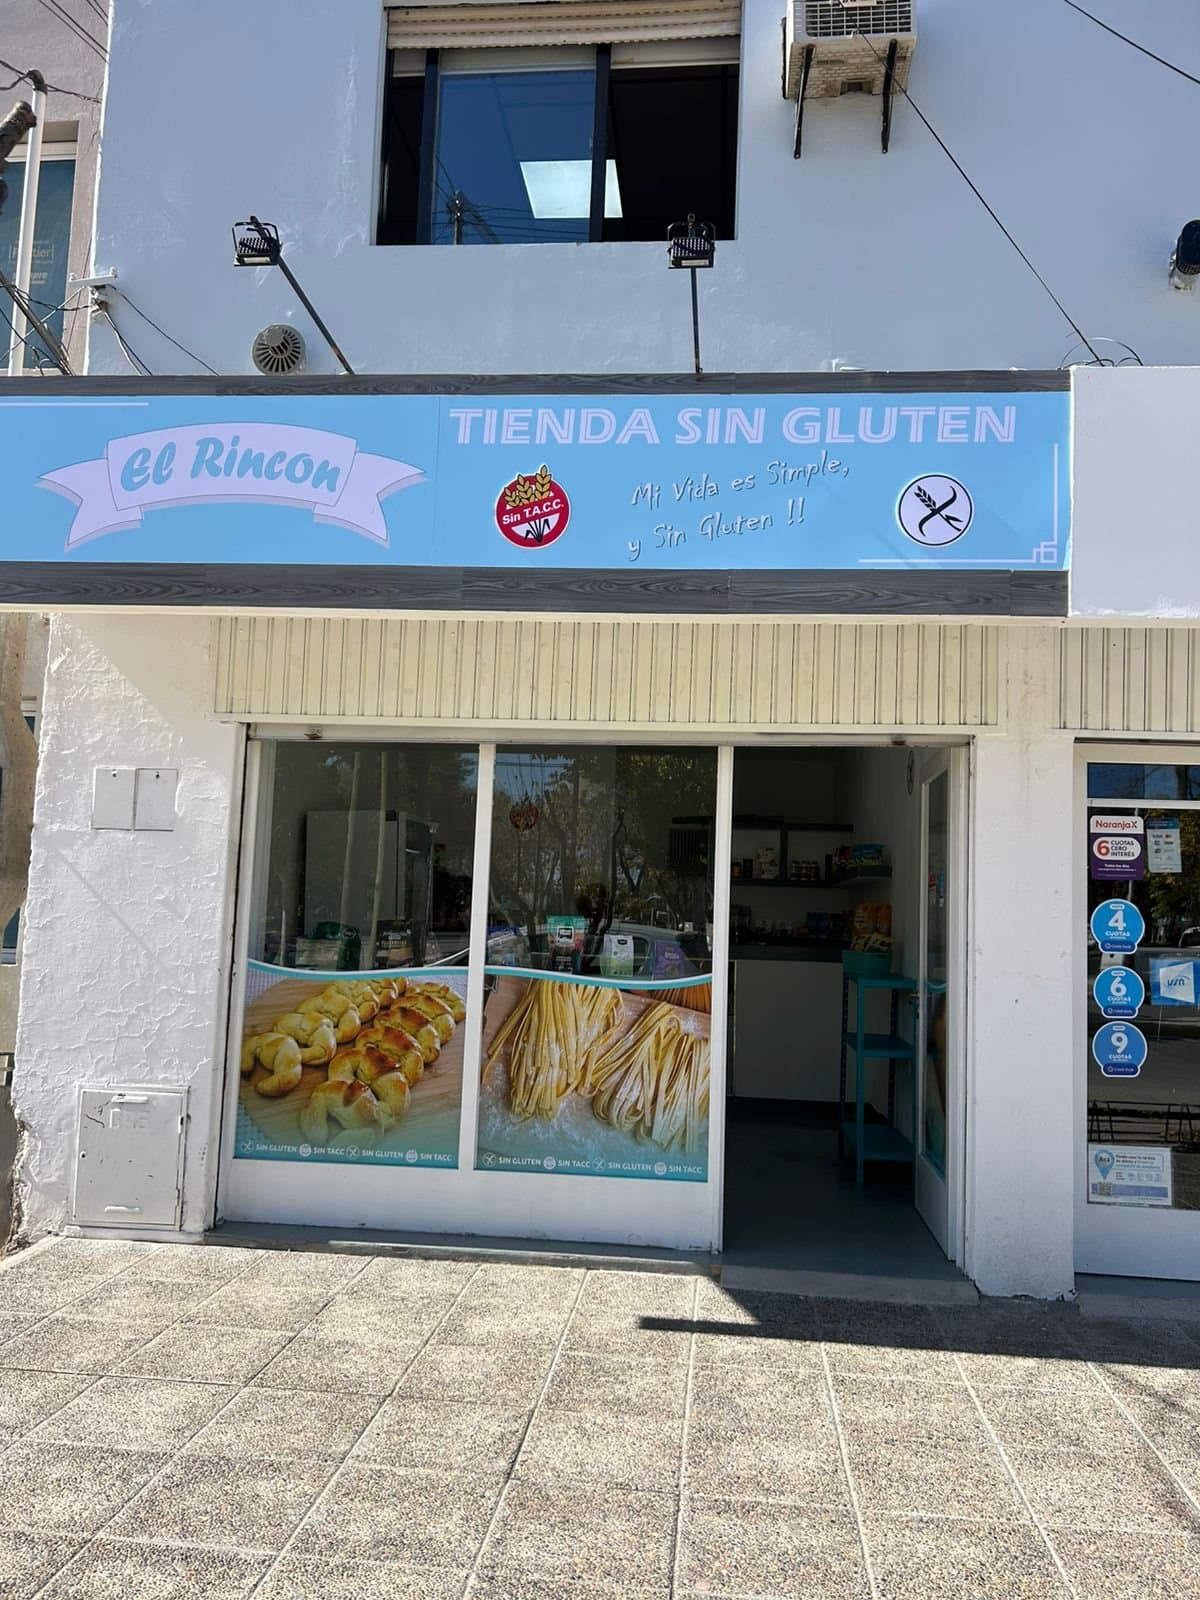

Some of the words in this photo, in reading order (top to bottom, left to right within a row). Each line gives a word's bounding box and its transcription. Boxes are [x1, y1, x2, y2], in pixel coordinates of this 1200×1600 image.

[449, 408, 660, 445] TIENDA
[675, 407, 766, 445] SIN
[782, 406, 1016, 444] GLUTEN
[120, 441, 177, 492] El
[190, 435, 341, 493] Rincon
[631, 482, 661, 510] Mi
[672, 473, 719, 502] Vida
[731, 473, 756, 492] es
[766, 450, 850, 487] Simple,
[502, 513, 521, 525] Sin
[627, 538, 641, 562] y
[653, 523, 687, 549] Sin
[699, 512, 774, 541] Gluten
[1096, 840, 1110, 857] 6
[1108, 911, 1127, 930] 4
[1110, 977, 1127, 996] 6
[1111, 1032, 1128, 1054] 9
[433, 1154, 451, 1162] TACC
